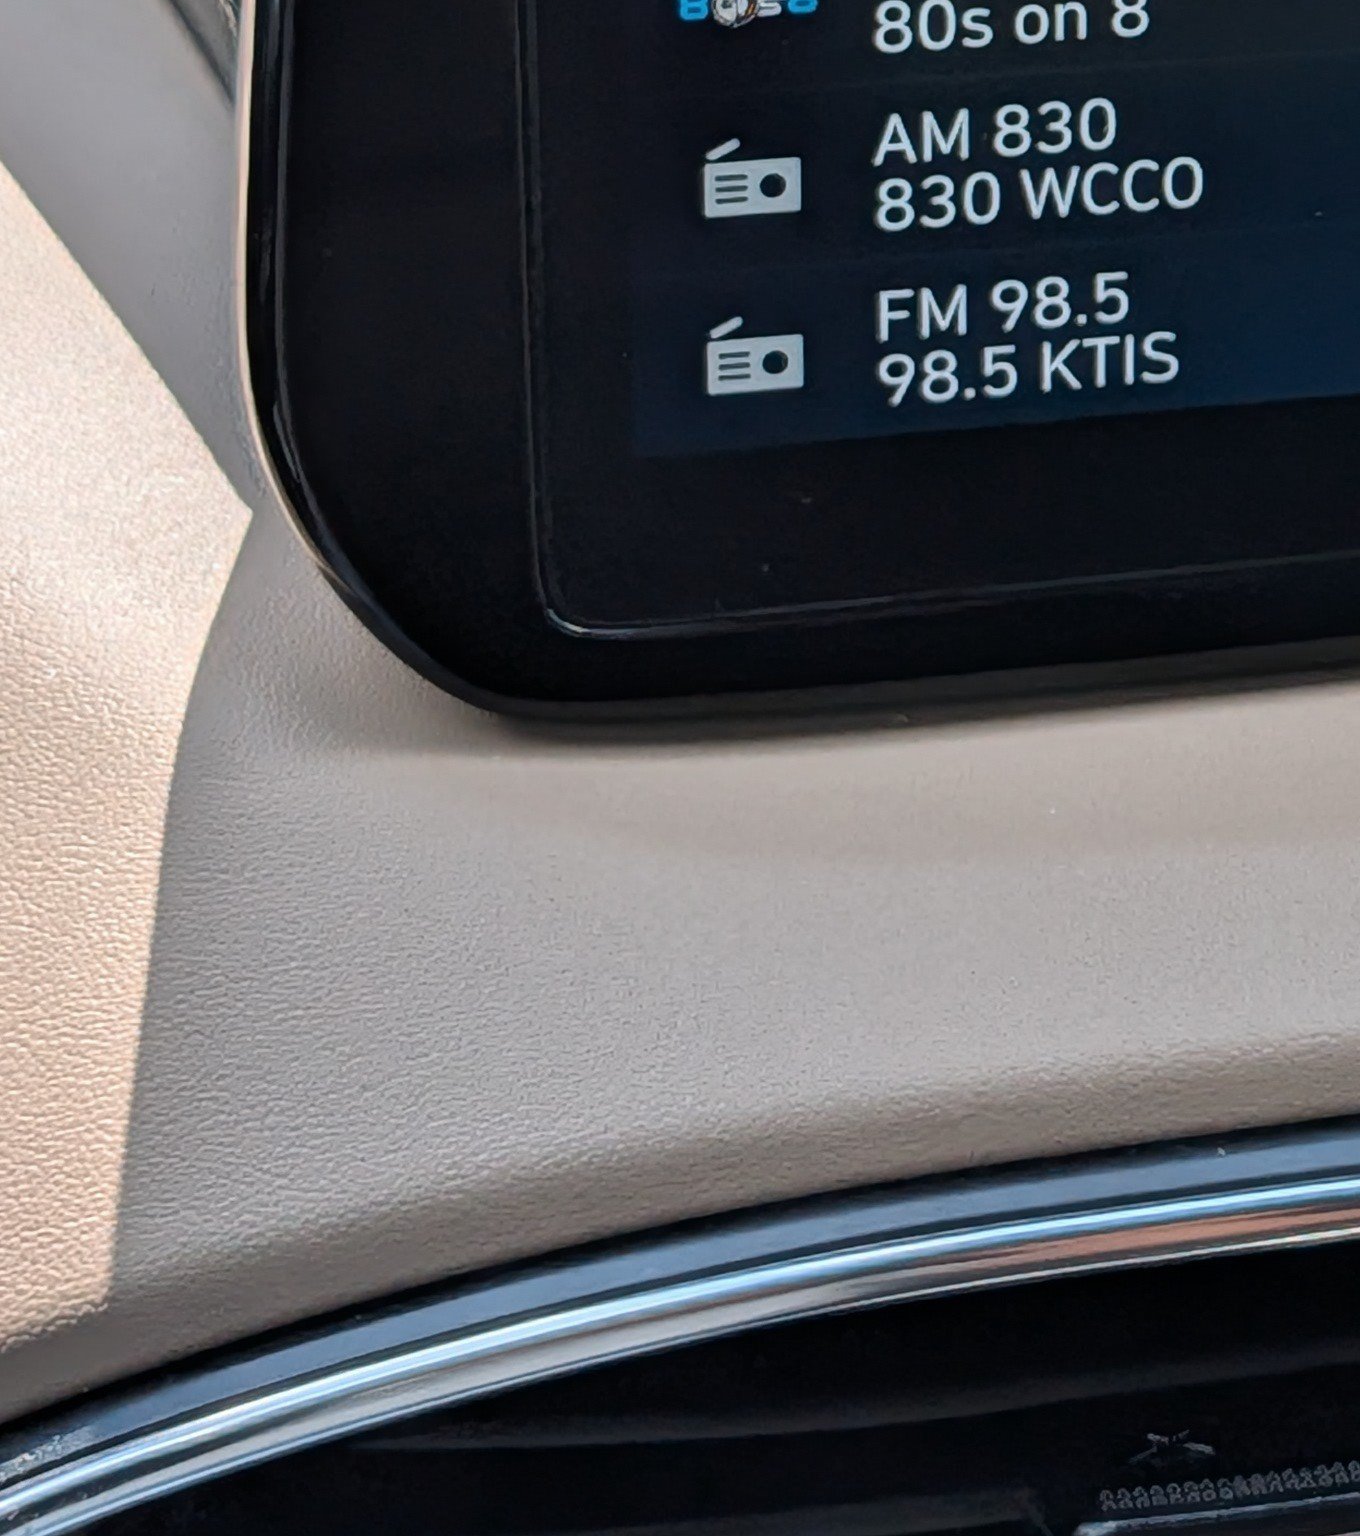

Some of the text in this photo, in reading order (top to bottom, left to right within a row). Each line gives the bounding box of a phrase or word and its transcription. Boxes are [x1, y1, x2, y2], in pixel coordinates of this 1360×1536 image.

[1014, 1, 1088, 45] on
[873, 97, 1117, 167] AM 830
[876, 156, 1204, 232] 830 WCCO
[878, 271, 1129, 342] FM 98.5
[878, 331, 1180, 406] 98.5 KTIS
